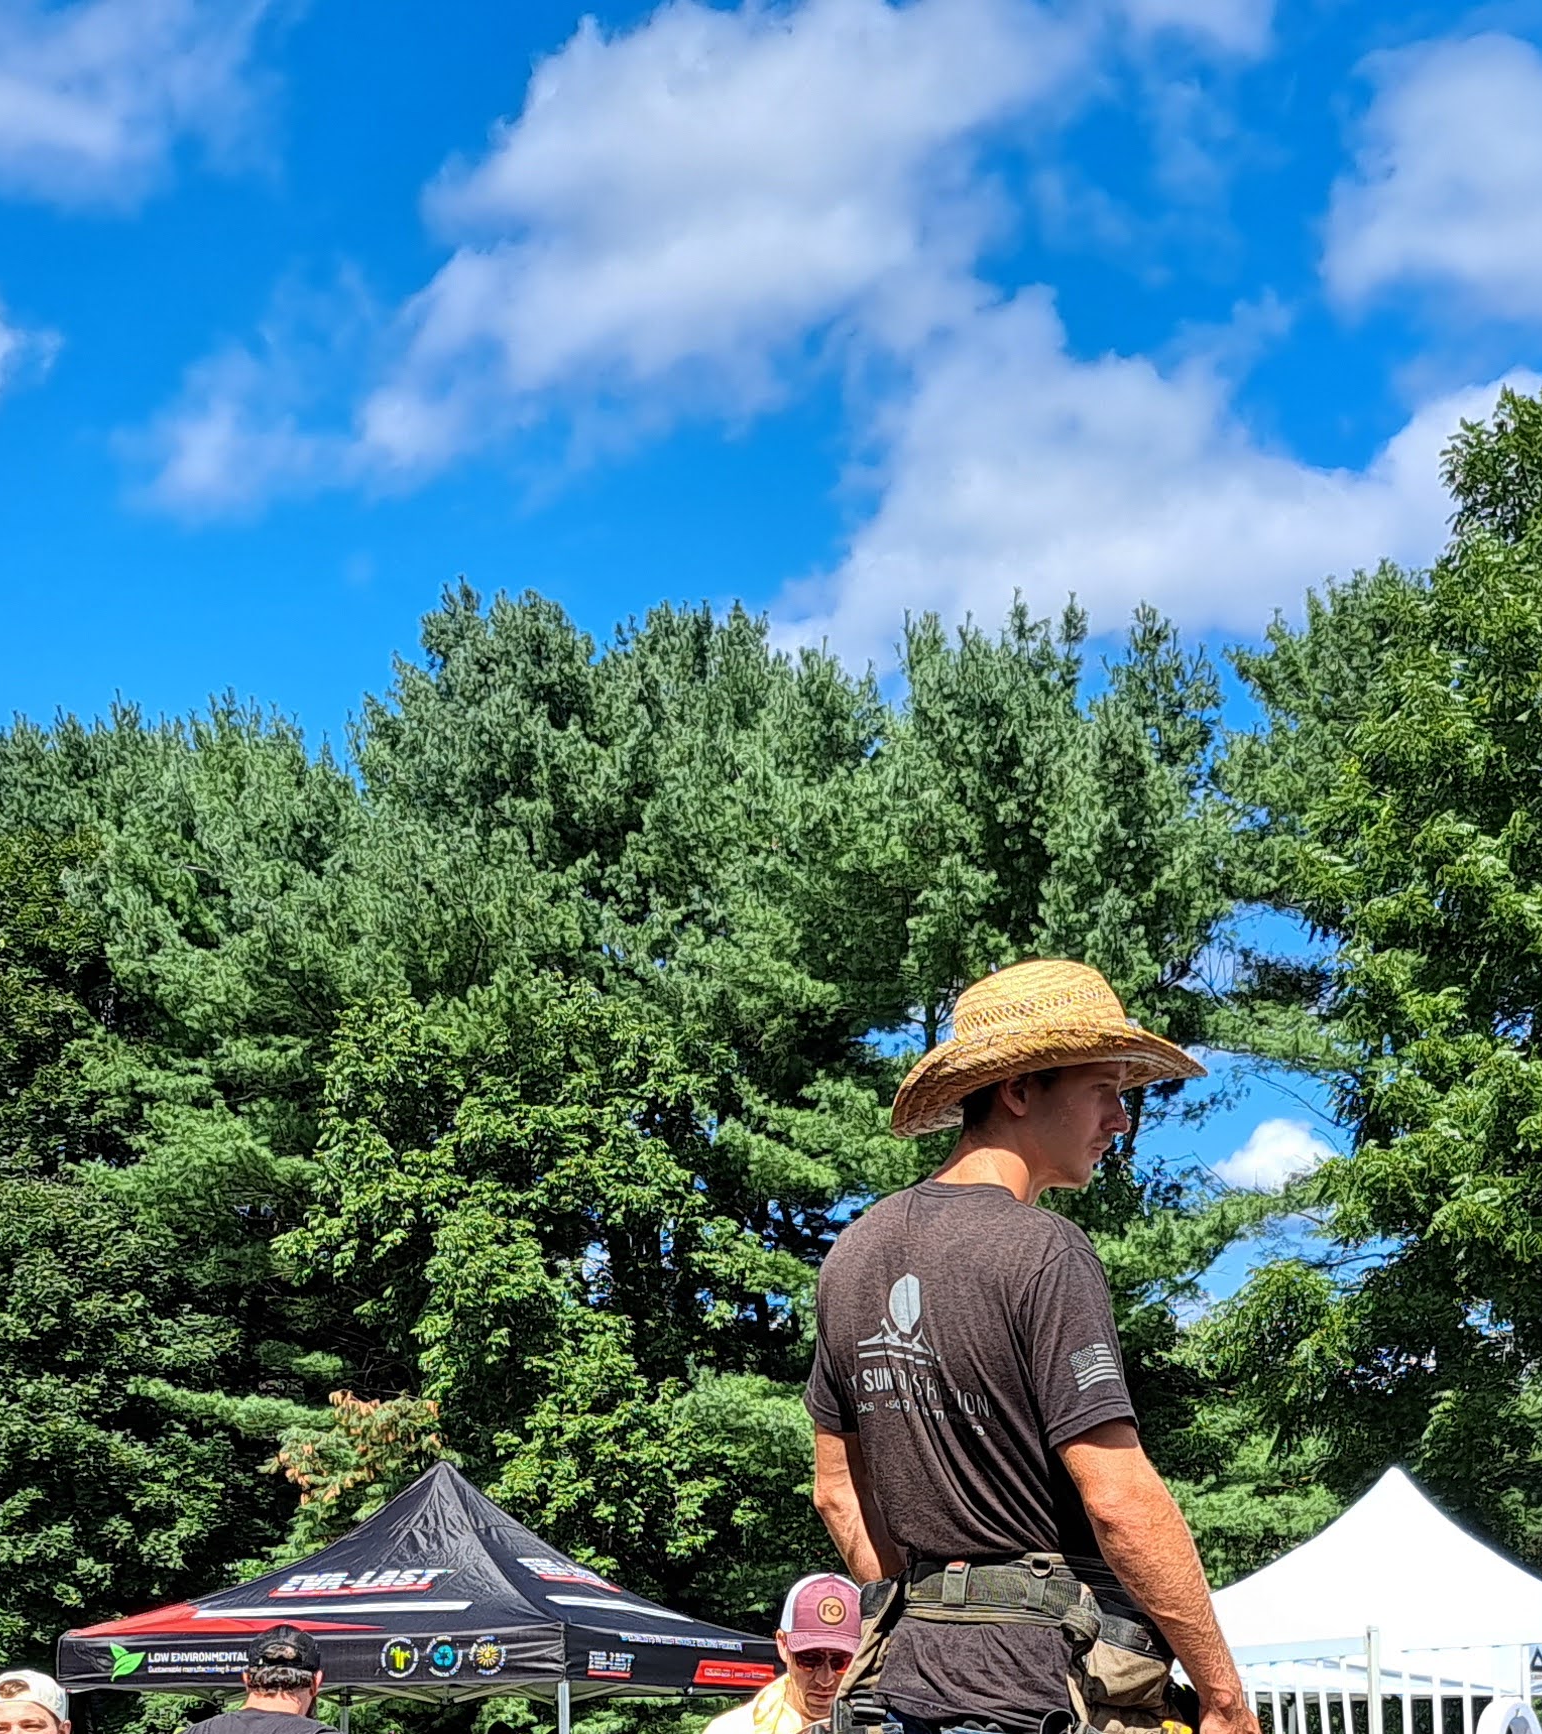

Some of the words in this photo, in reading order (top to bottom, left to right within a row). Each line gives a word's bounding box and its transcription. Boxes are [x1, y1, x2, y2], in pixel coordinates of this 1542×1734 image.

[862, 1367, 894, 1392] SUN
[277, 1569, 457, 1592] EVA-LAST
[148, 1651, 170, 1663] LOW
[171, 1650, 249, 1662] ENVIRONMENTAL
